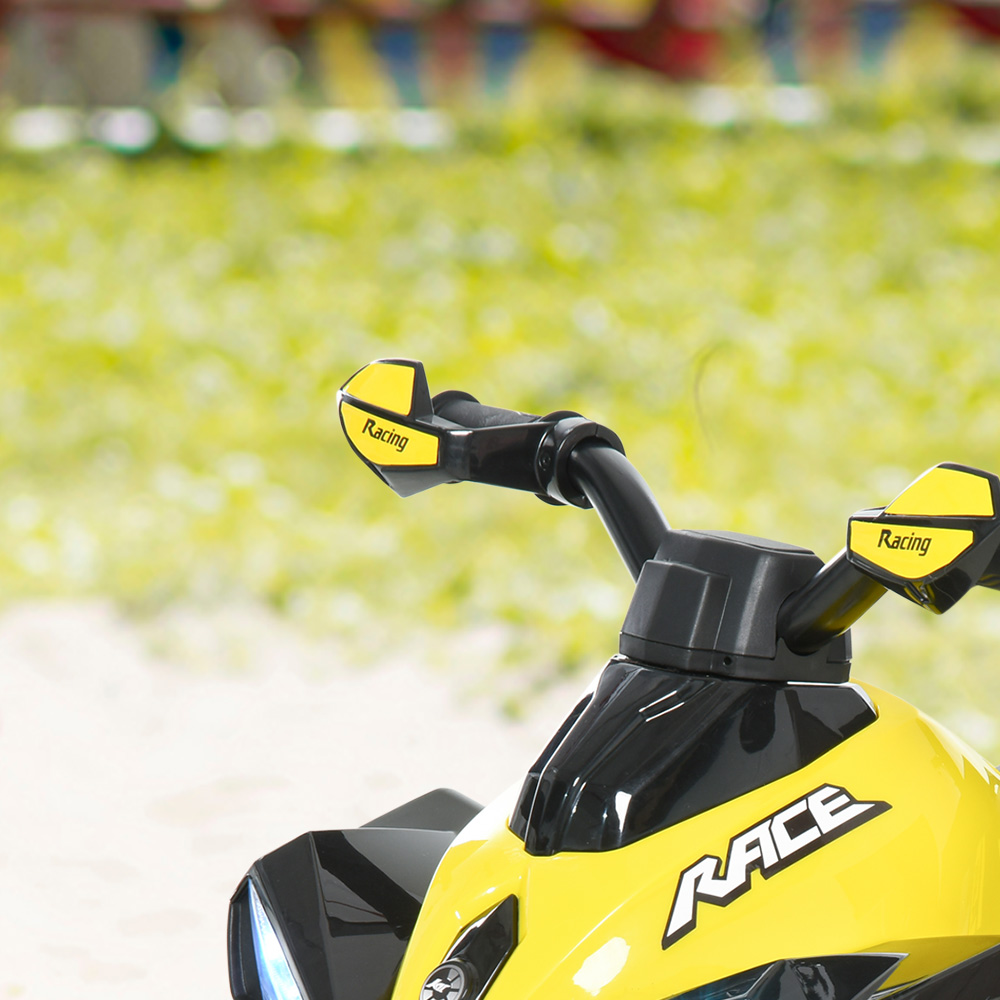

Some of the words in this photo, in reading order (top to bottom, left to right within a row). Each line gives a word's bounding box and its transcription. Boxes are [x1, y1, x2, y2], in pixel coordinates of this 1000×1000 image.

[362, 418, 409, 452] Racing
[877, 529, 932, 556] Racing
[662, 783, 888, 950] RACE
